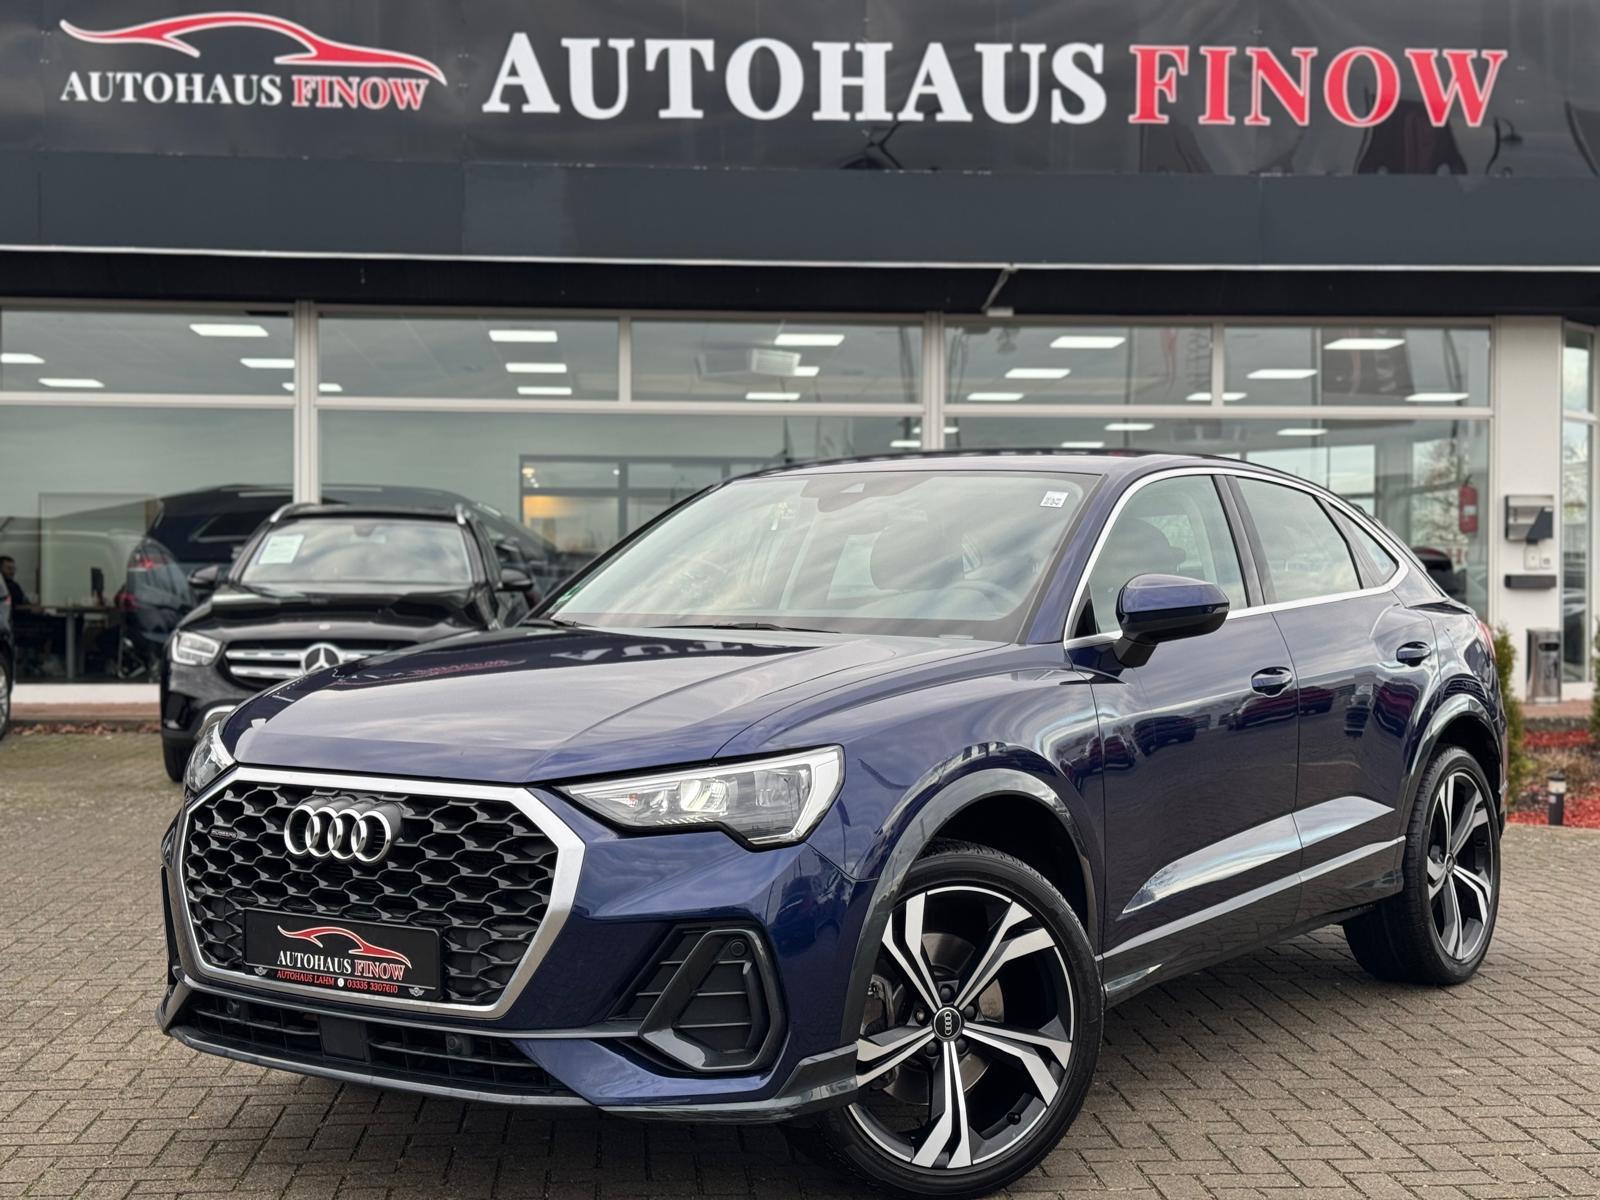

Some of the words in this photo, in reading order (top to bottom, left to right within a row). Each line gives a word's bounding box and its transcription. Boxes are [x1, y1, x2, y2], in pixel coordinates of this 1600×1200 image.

[60, 70, 282, 105] AUTOHAUS
[292, 74, 429, 110] FINOW
[482, 32, 1107, 125] AUTOHAUS
[1128, 44, 1508, 128] FINOW
[277, 950, 351, 974] AUTOHAUS
[354, 959, 405, 980] FINOW
[277, 970, 313, 983] AUTOHAUS
[314, 974, 335, 986] LAHM
[346, 980, 368, 990] 03335
